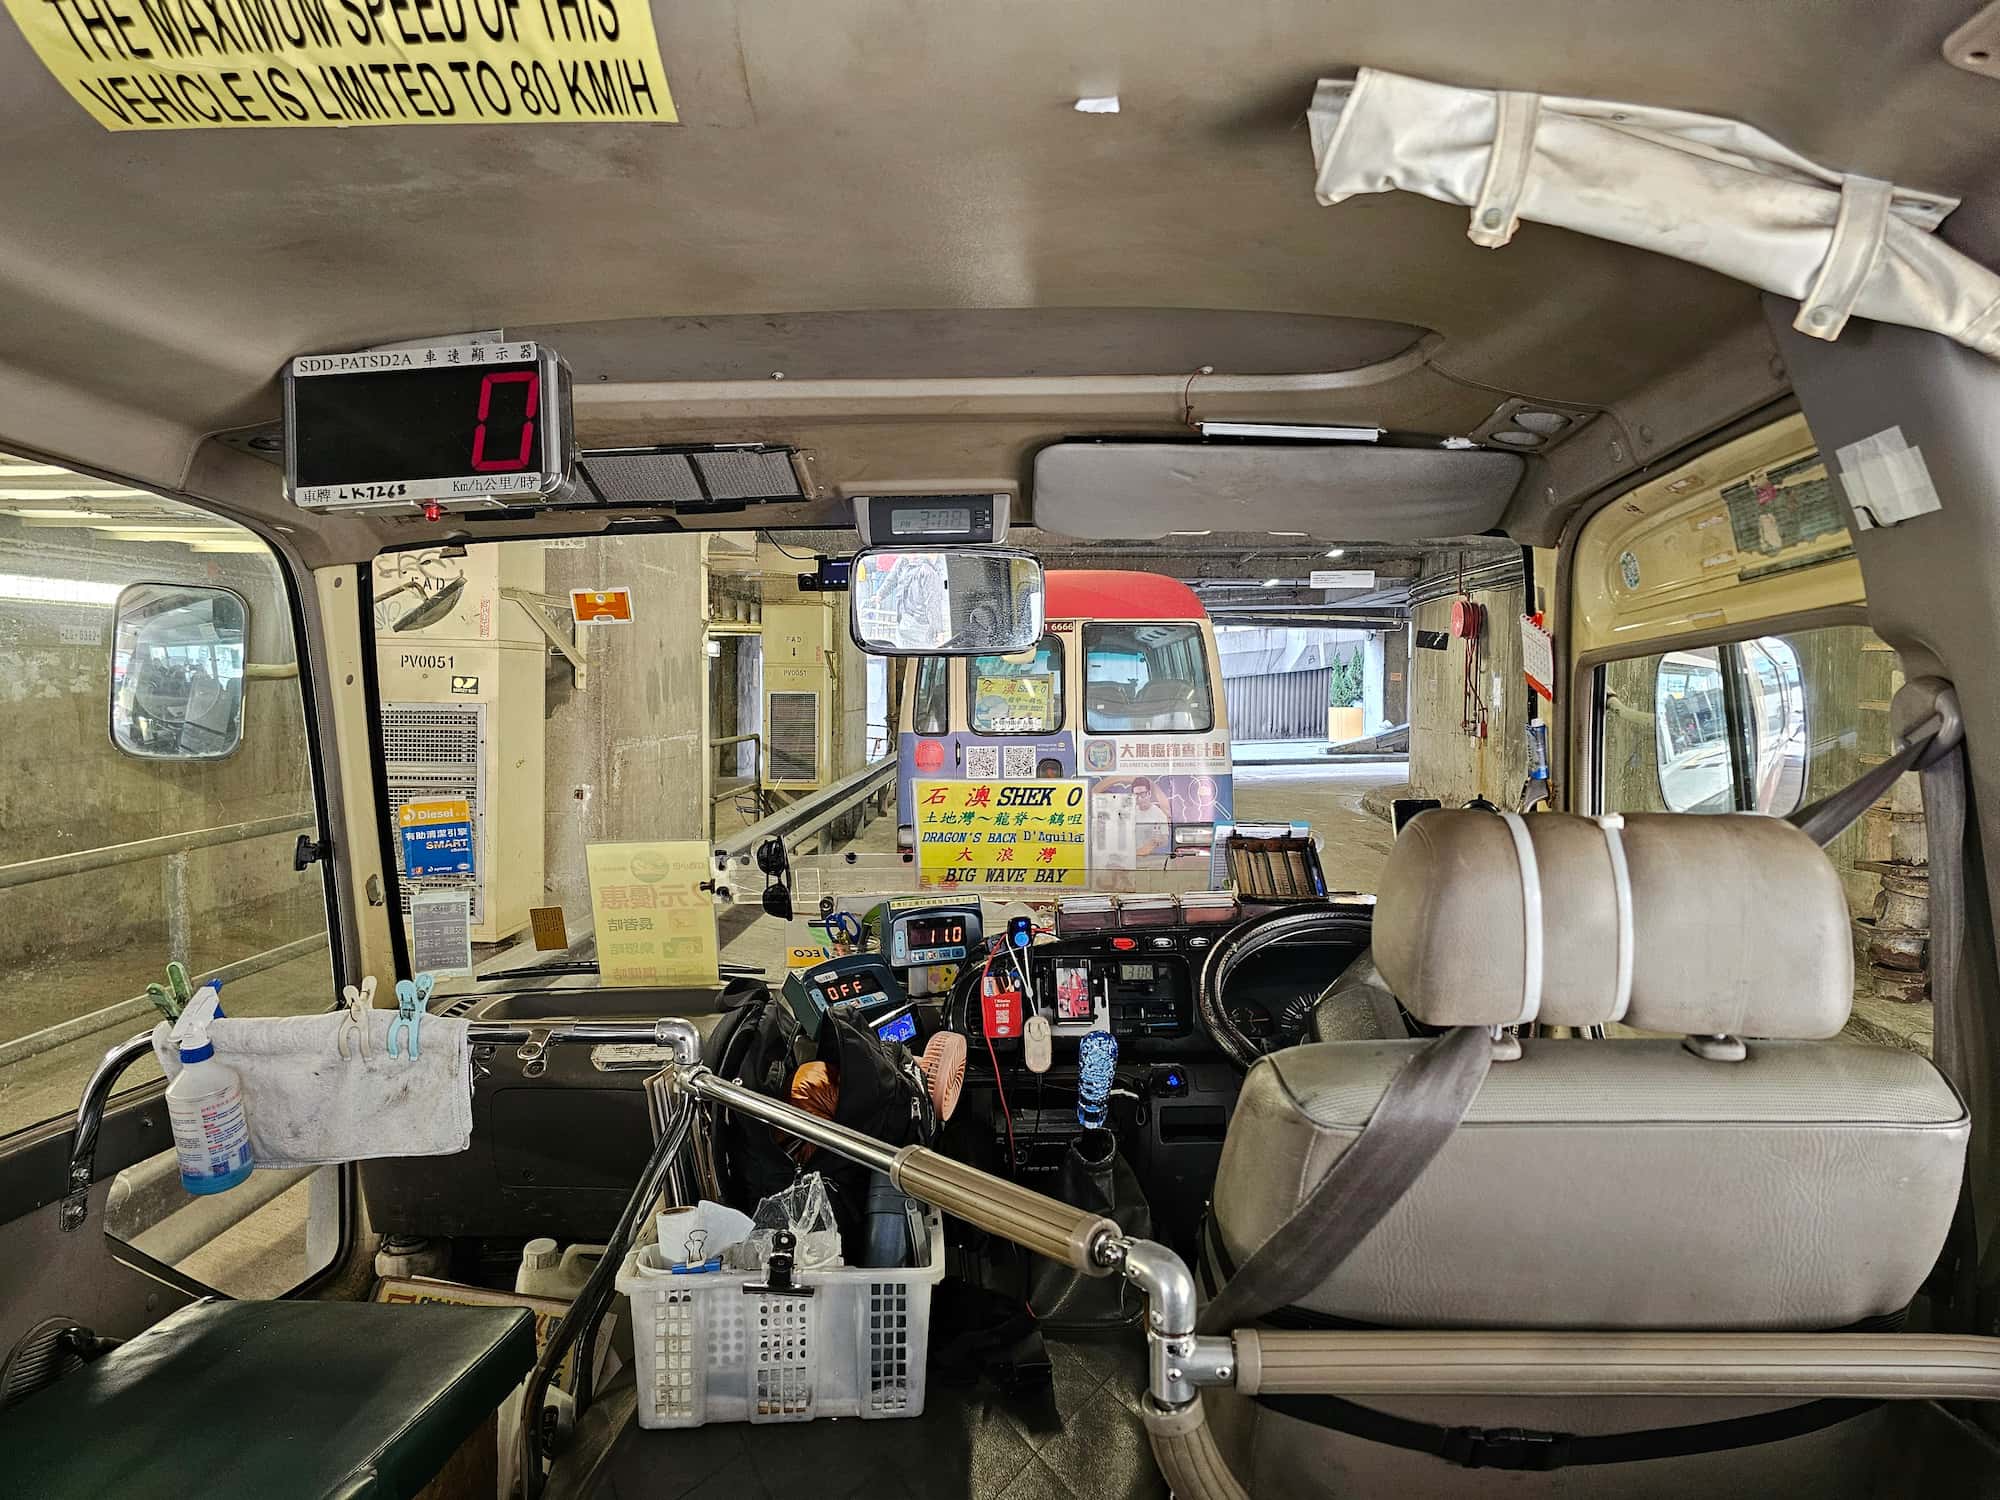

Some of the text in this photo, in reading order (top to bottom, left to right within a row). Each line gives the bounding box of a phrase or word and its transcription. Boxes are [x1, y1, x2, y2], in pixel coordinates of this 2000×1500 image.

[42, 0, 620, 62] THE MAXIMUM SPEED OF THIS
[79, 59, 659, 125] VEHICLE IS LIMITED TO 80 KM/H
[299, 355, 414, 373] SDD-PATSD2A
[471, 371, 539, 472] 0
[401, 654, 454, 669] PV0051
[922, 785, 991, 808] 石澳
[996, 786, 1057, 807] SHEK
[417, 808, 454, 820] Diesel
[426, 839, 468, 850] SMART
[922, 831, 983, 843] DRAGON'S
[987, 831, 1018, 843] BACK
[955, 847, 1057, 864] 大浪灣
[944, 868, 977, 883] BIG
[985, 868, 1027, 883] WAVE
[1034, 868, 1068, 883] BAY
